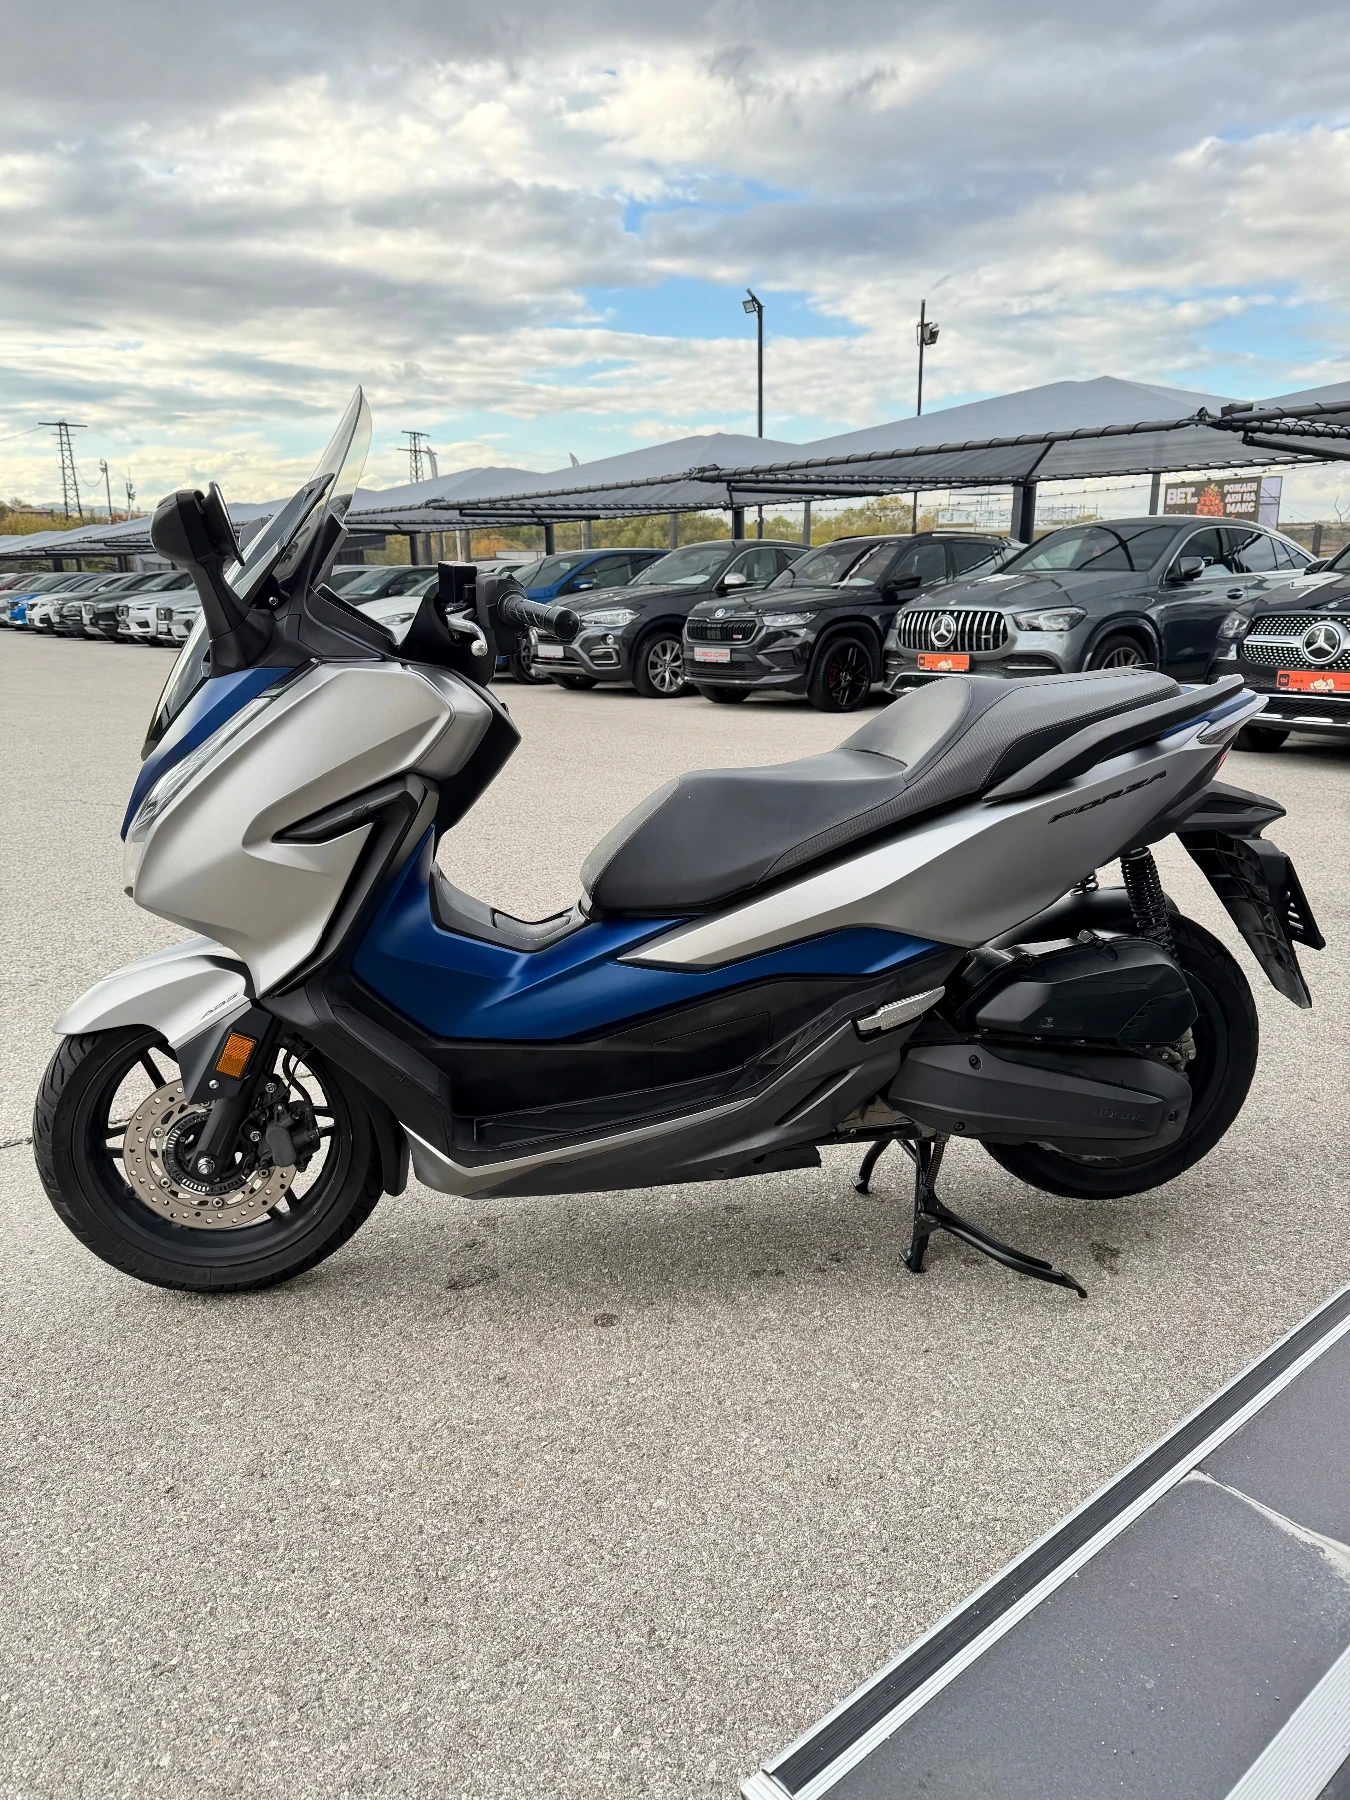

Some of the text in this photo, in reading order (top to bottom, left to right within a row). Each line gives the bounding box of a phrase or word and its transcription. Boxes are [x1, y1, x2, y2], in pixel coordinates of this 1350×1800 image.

[1224, 482, 1257, 493] РОЖДЕН
[1225, 492, 1256, 503] ДЕН НА
[1226, 503, 1255, 513] МАКС
